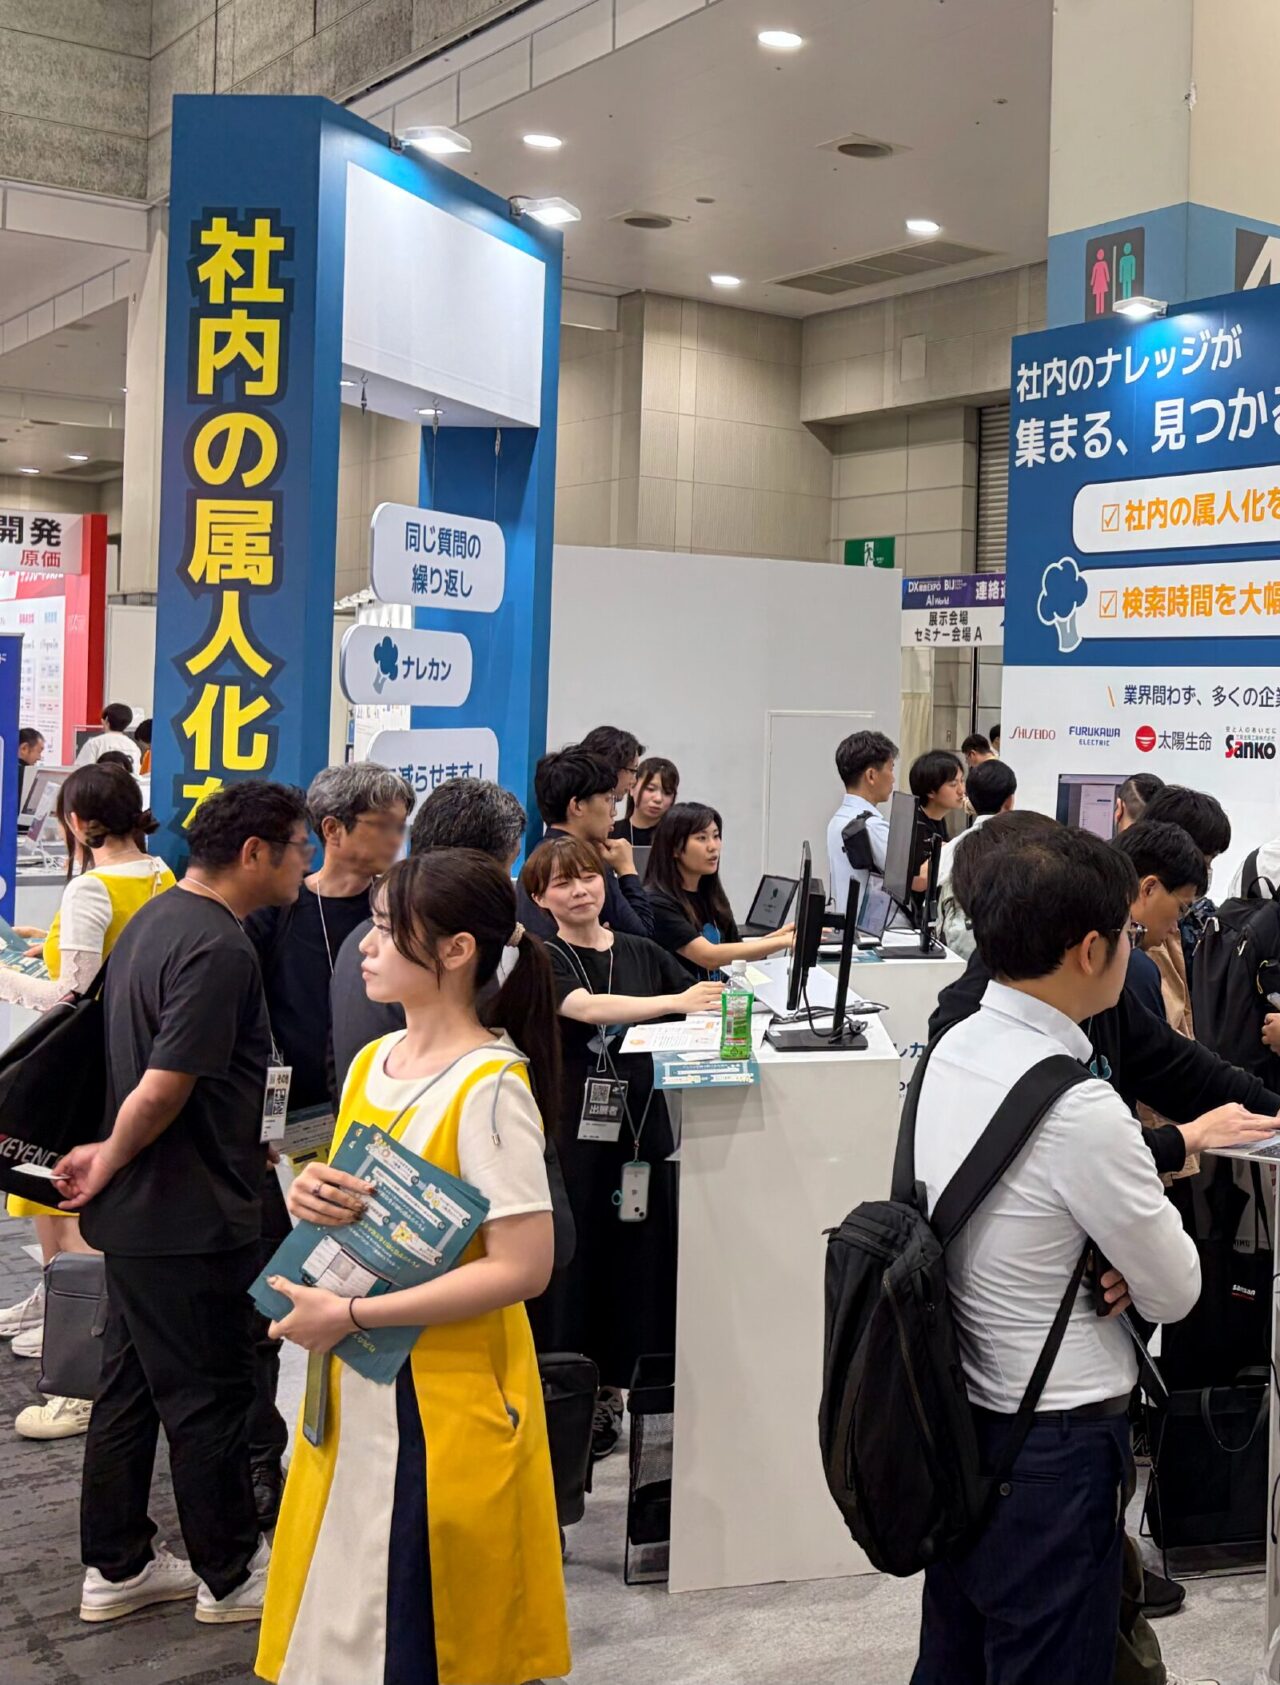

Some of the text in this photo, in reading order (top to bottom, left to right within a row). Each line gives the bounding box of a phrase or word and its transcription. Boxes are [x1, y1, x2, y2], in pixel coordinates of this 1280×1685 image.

[1016, 323, 1244, 402] 社内のナレッジが
[181, 217, 285, 829] 社内の属人化
[405, 521, 481, 560] 同じ質問の
[20, 549, 62, 568] 原価
[411, 563, 473, 598] 繰り返し
[928, 610, 969, 627] 展示会場
[914, 626, 983, 643] セミナー会場 A
[402, 656, 452, 682] ナレカン
[1009, 726, 1056, 740] SHISEIDO
[1069, 726, 1121, 737] FURUKAWA
[1158, 730, 1213, 752] 太陽生命
[0, 1137, 64, 1167] KEYENC
